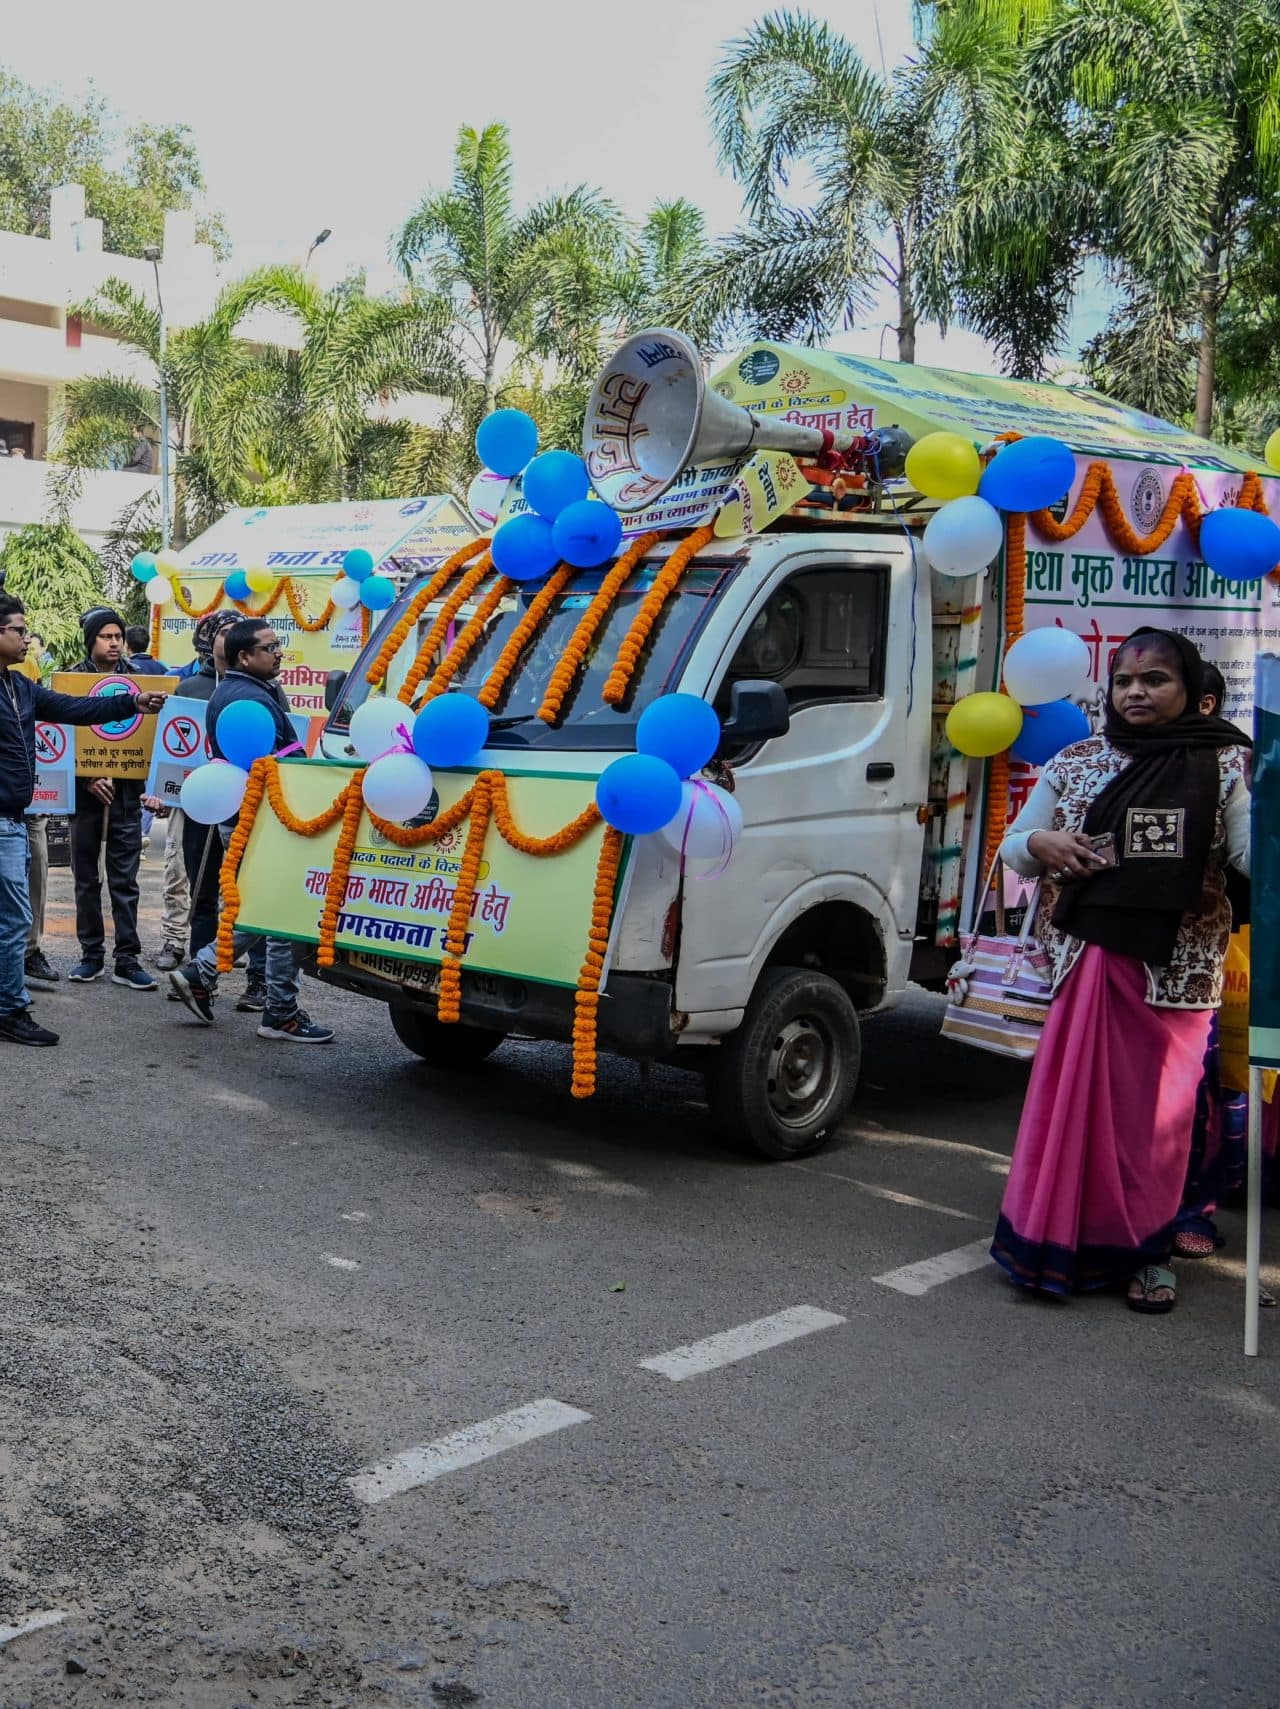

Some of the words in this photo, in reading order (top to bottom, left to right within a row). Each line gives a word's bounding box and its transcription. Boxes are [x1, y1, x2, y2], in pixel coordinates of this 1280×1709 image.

[847, 400, 874, 431] हेतु
[646, 510, 662, 523] का
[1072, 554, 1115, 608] मुक्त
[1122, 557, 1177, 597] भारत
[380, 852, 415, 868] पदार्थों
[418, 856, 432, 870] के
[369, 877, 409, 907] भारत
[481, 884, 511, 931] हेतु
